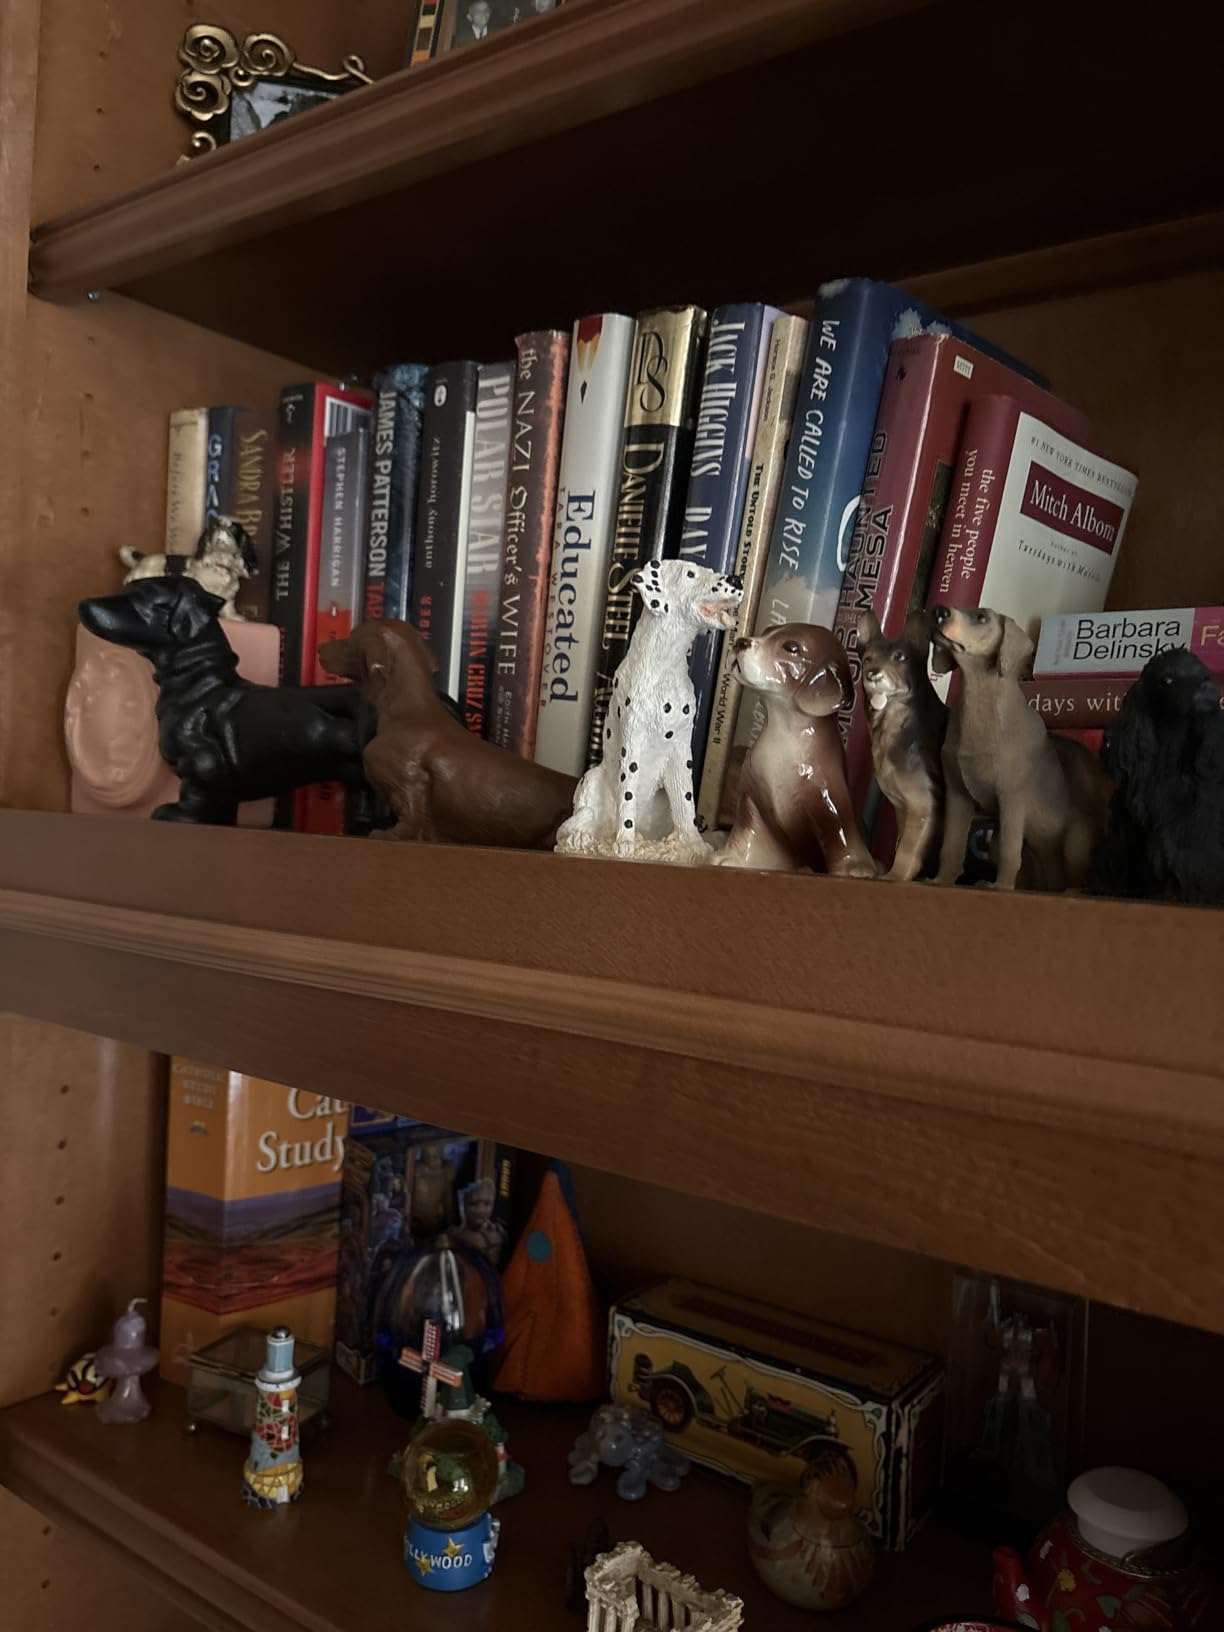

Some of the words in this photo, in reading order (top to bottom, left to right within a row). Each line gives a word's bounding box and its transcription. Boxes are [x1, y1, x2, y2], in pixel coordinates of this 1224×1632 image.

[706, 319, 746, 375] JACK
[820, 319, 841, 352] WE
[519, 350, 538, 380] the
[810, 356, 833, 402] ARE
[375, 391, 398, 456] JAMES
[473, 375, 511, 483] POLAR
[512, 390, 536, 472] NAZI
[690, 382, 738, 478] HIGGINS
[797, 409, 825, 481] CALLED
[237, 428, 269, 506] SANDRA
[333, 447, 347, 511] STEPHEN
[425, 437, 441, 504] horowitz
[753, 463, 765, 487] THE
[964, 449, 978, 477] you
[978, 469, 996, 494] the
[1041, 441, 1055, 456] NEW
[1056, 451, 1073, 469] YORK
[1075, 462, 1096, 480] TIMES
[274, 447, 297, 555] WHISTLER
[367, 460, 393, 577] PATTERSON
[554, 487, 567, 549] TARA
[613, 443, 666, 561] DANIELLE
[746, 490, 760, 538] UNTOLD
[791, 485, 809, 511] TO
[839, 430, 888, 609] HAUNTED
[955, 482, 971, 520] meet
[972, 496, 991, 526] five
[1029, 479, 1068, 522] Mitch
[1070, 501, 1117, 543] Albom
[330, 516, 344, 588] HARRIGAN
[424, 508, 439, 568] anthony
[467, 495, 503, 575] STAR
[504, 485, 528, 586] Officer's
[778, 516, 807, 571] RISE
[853, 504, 894, 611] MESA
[952, 523, 967, 538] in
[960, 527, 980, 579] people
[275, 559, 291, 601] THE
[550, 489, 596, 704] Educated
[939, 543, 963, 593] heaven
[497, 594, 521, 676] WIFE
[601, 561, 644, 651] STEEL
[1075, 617, 1181, 641] Barbara
[539, 572, 559, 708] WESTOVER
[1200, 624, 1224, 647] Fa
[718, 672, 731, 708] World
[1086, 692, 1126, 712] wit
[713, 709, 726, 735] War
[256, 1120, 346, 1172] Study
